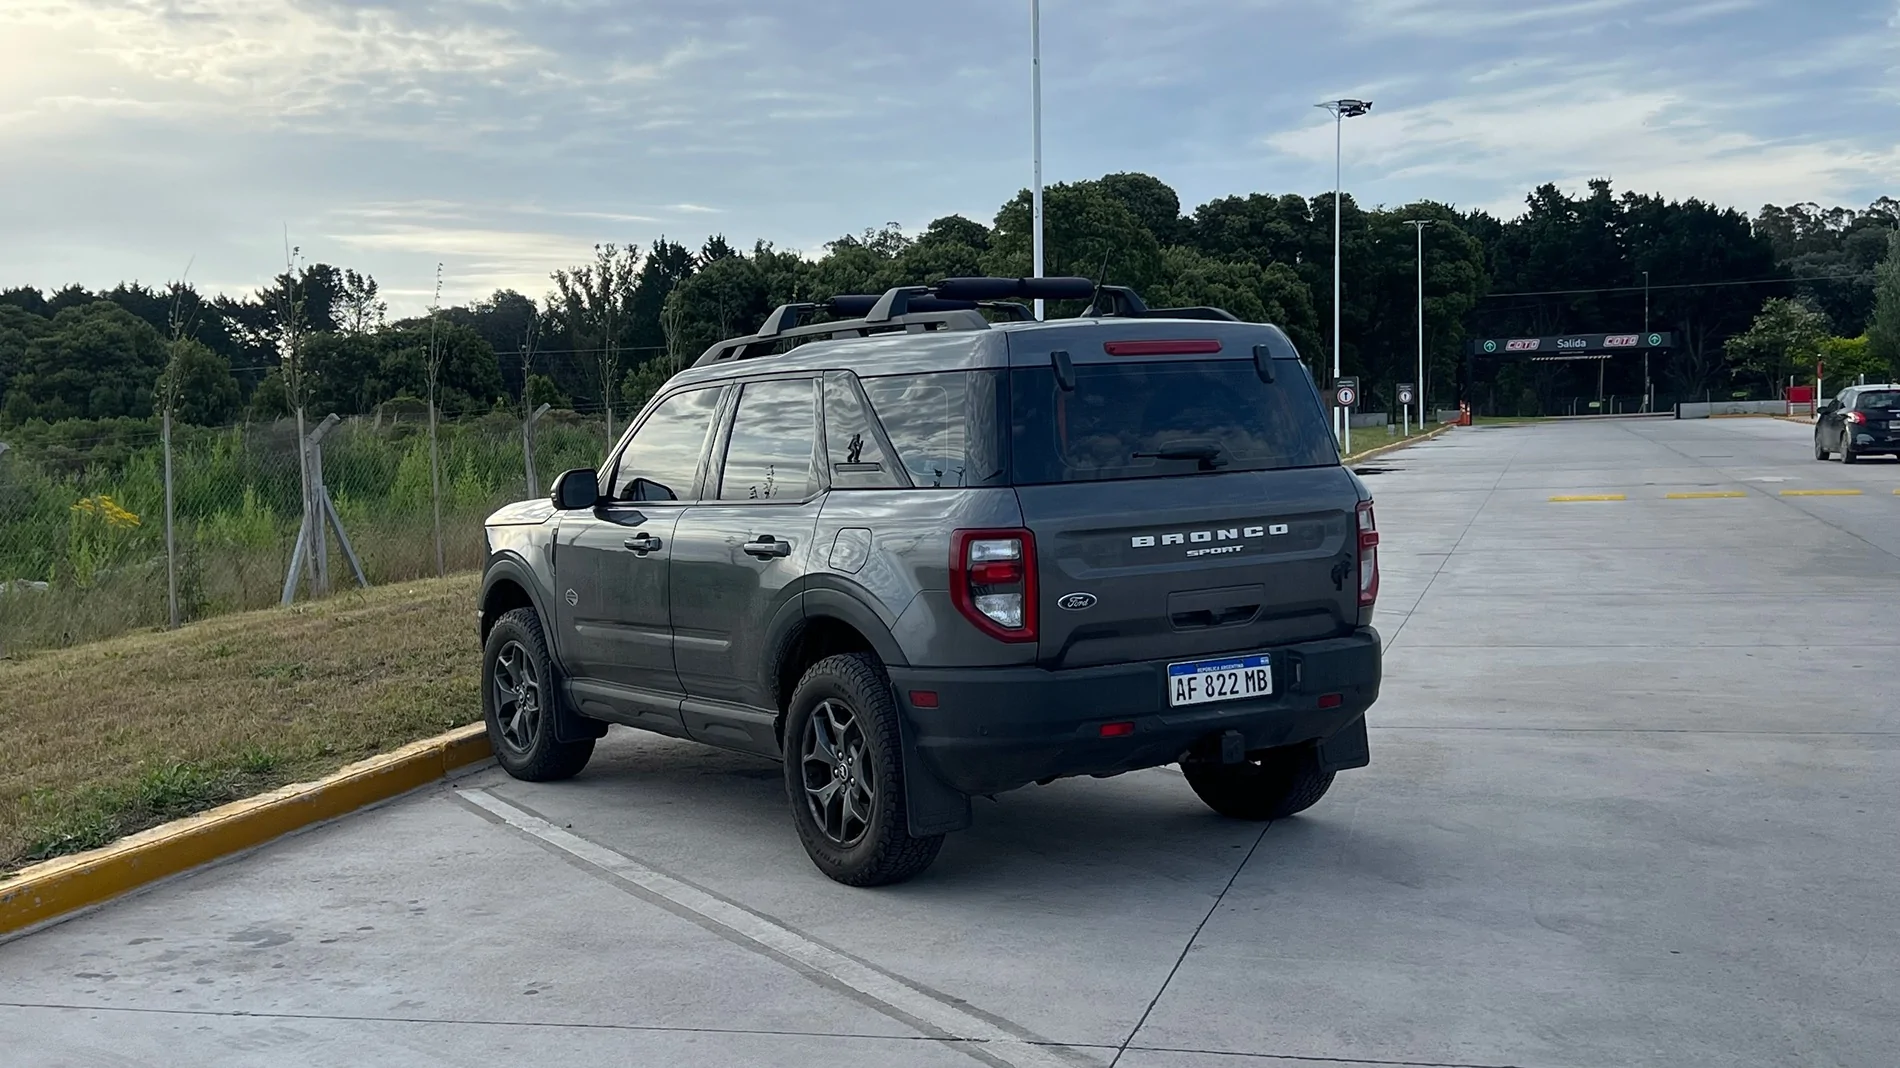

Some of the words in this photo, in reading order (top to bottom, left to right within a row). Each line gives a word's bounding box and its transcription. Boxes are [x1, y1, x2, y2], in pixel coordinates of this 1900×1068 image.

[1508, 340, 1539, 349] COTO
[1557, 339, 1587, 348] Salida
[1605, 336, 1638, 346] COTO
[1132, 523, 1288, 548] BRONCO
[1186, 545, 1244, 557] SPORT
[1067, 596, 1089, 608] Ford
[1176, 677, 1197, 702] AF
[1205, 672, 1239, 698] 822
[1244, 669, 1268, 694] MB
